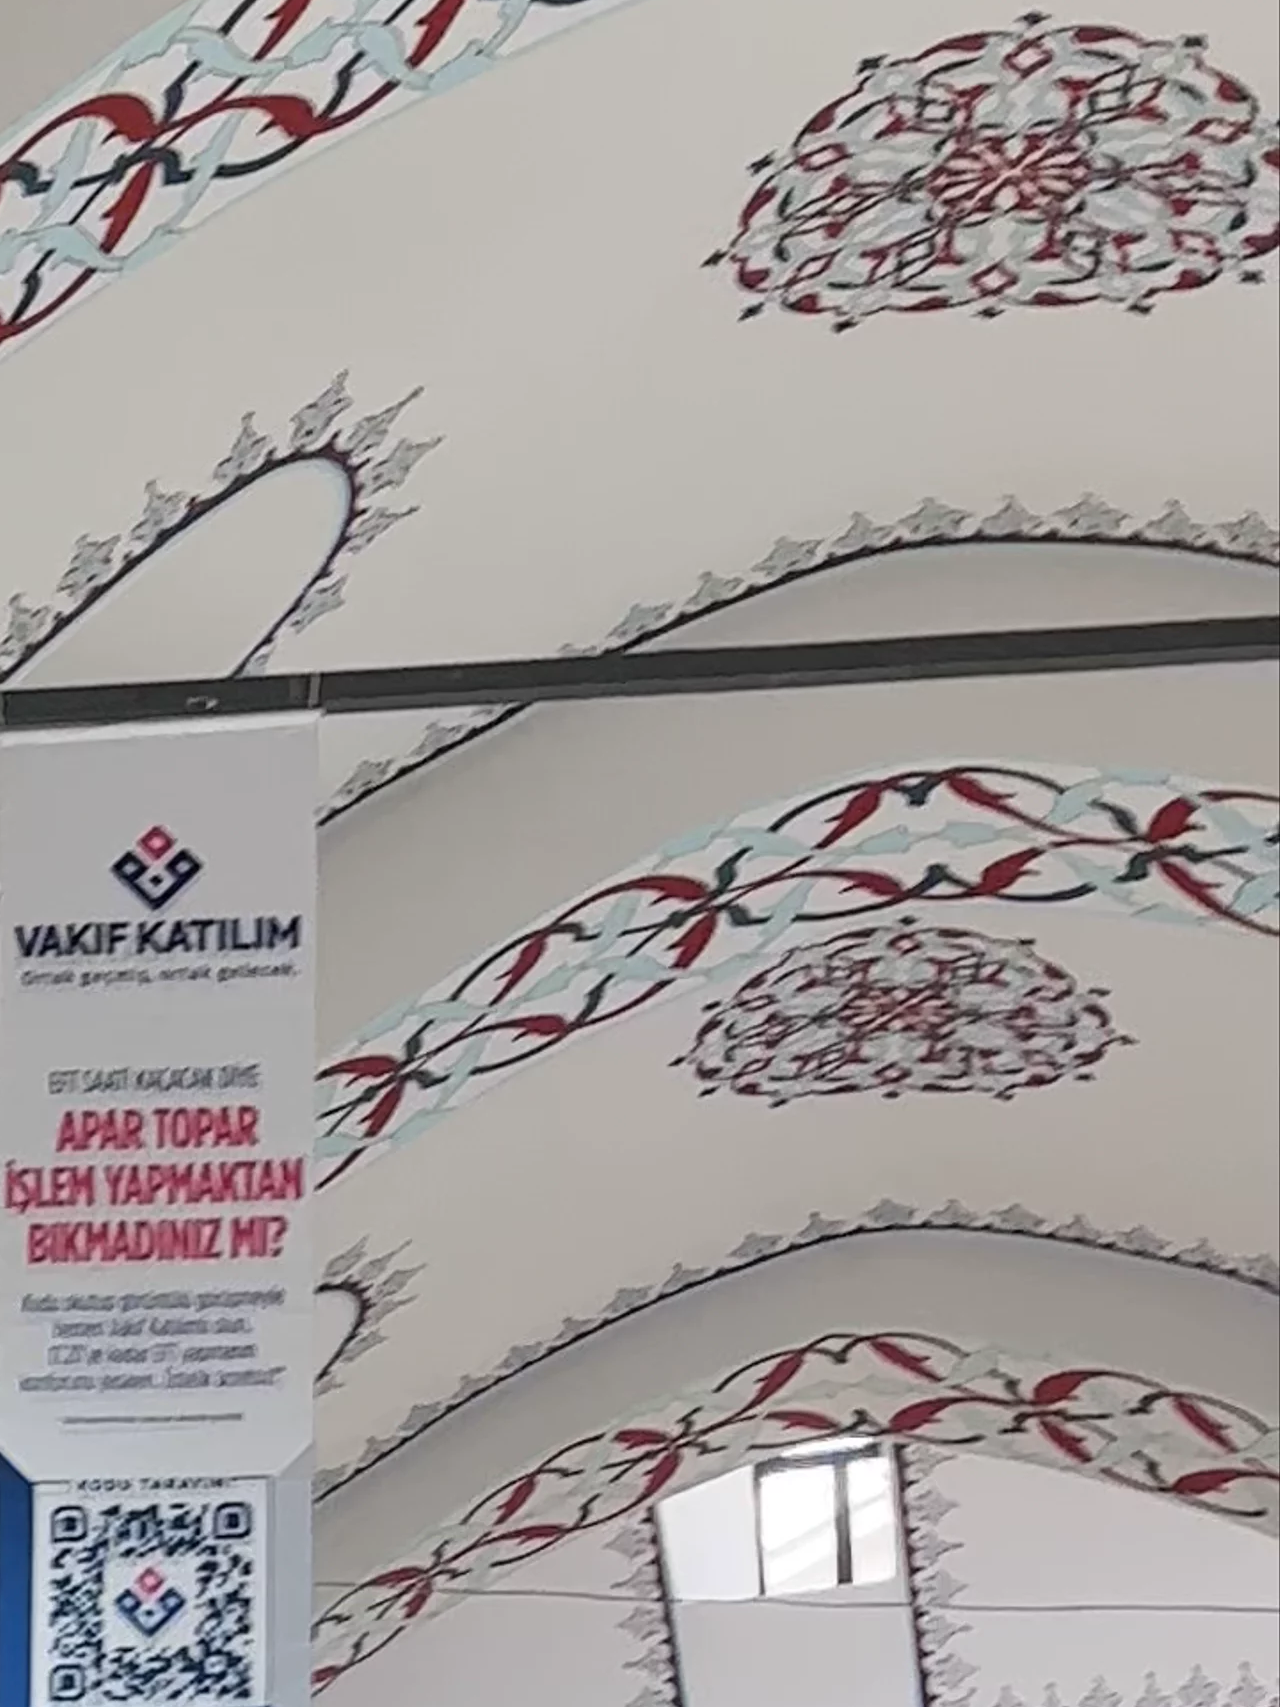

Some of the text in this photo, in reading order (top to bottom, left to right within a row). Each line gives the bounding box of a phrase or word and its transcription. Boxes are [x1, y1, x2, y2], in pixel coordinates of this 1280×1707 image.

[15, 916, 301, 957] VAKIF KATILIM
[57, 1106, 260, 1151] APAR TOPAR
[4, 1156, 305, 1215] İŞLEM YAPMAKTAN
[26, 1215, 291, 1265] BIKMADINIZ MI?
